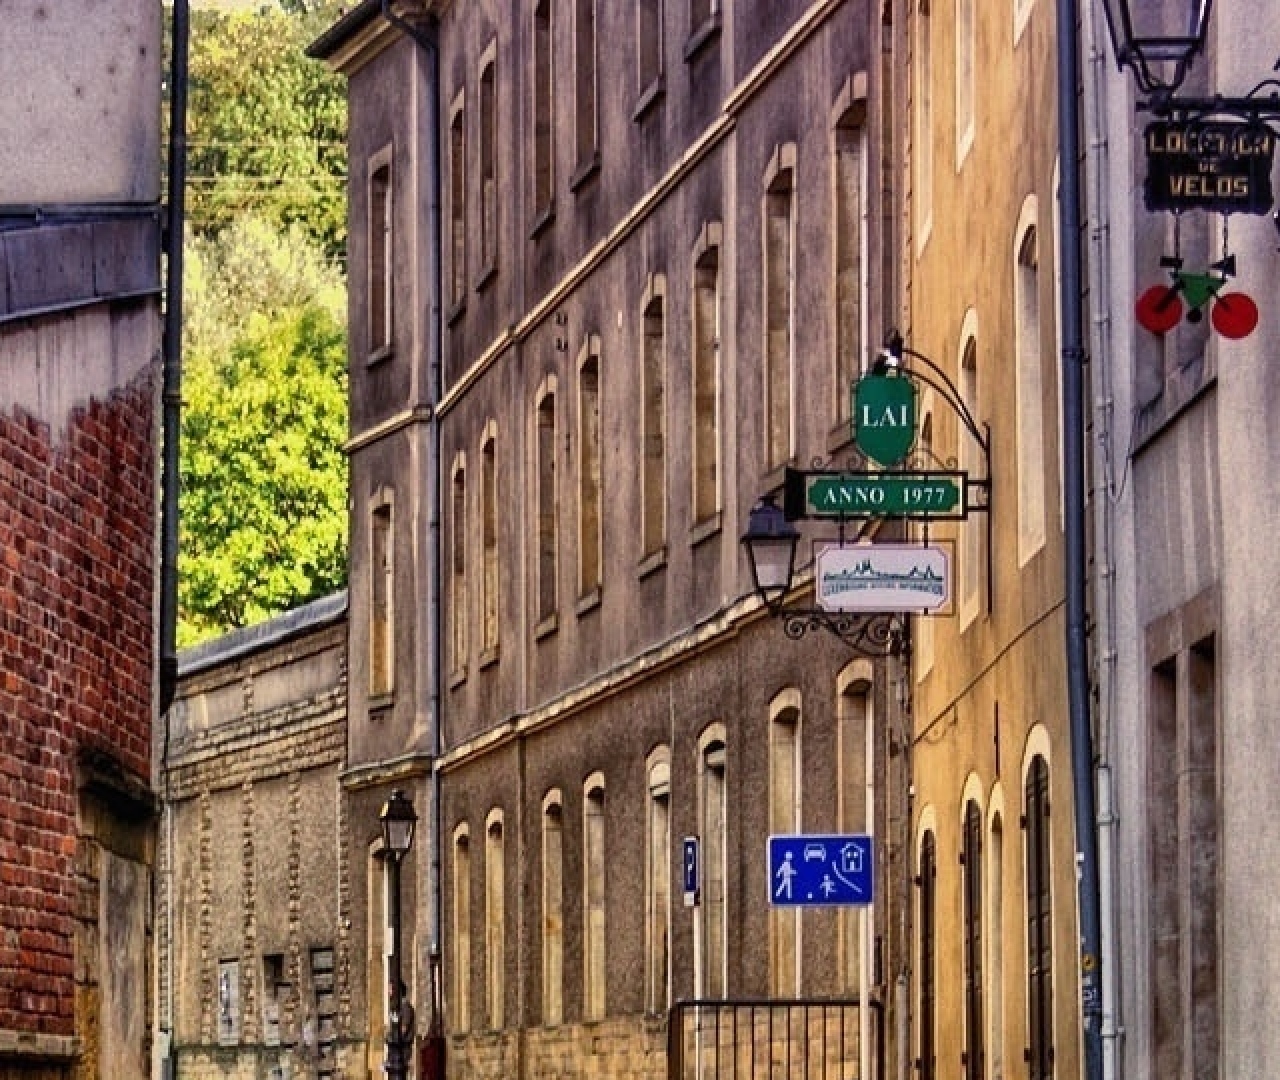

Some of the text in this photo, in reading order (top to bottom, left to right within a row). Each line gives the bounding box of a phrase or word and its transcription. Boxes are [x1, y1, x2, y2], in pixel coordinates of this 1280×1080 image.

[1170, 175, 1248, 196] VELOS
[863, 405, 907, 427] LAI
[824, 487, 945, 504] ANNO 1977
